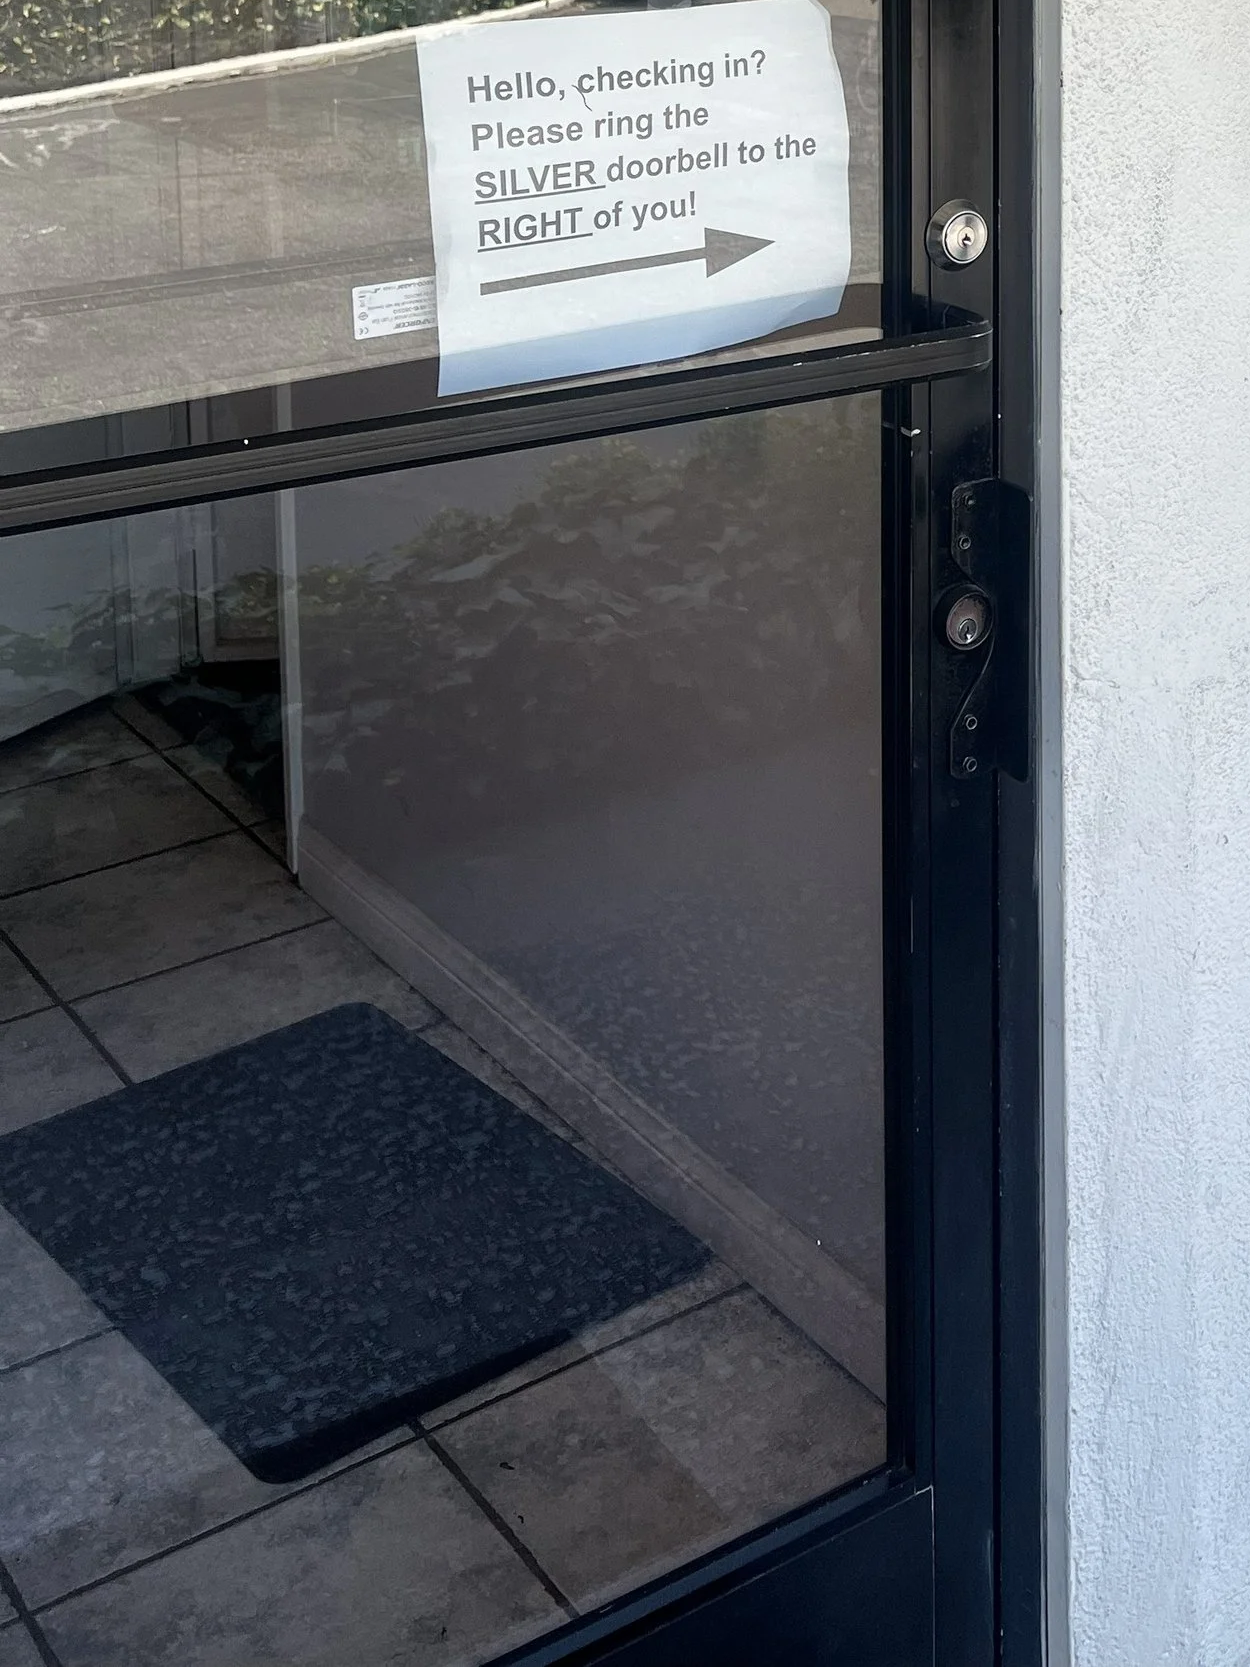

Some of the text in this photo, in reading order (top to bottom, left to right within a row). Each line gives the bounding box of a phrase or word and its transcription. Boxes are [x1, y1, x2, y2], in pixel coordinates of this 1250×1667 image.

[467, 49, 767, 104] Hello, checking in?
[471, 102, 709, 151] Please ring the
[474, 133, 816, 199] SILVER doorbell to the
[477, 191, 697, 247] RIGHT of you!
